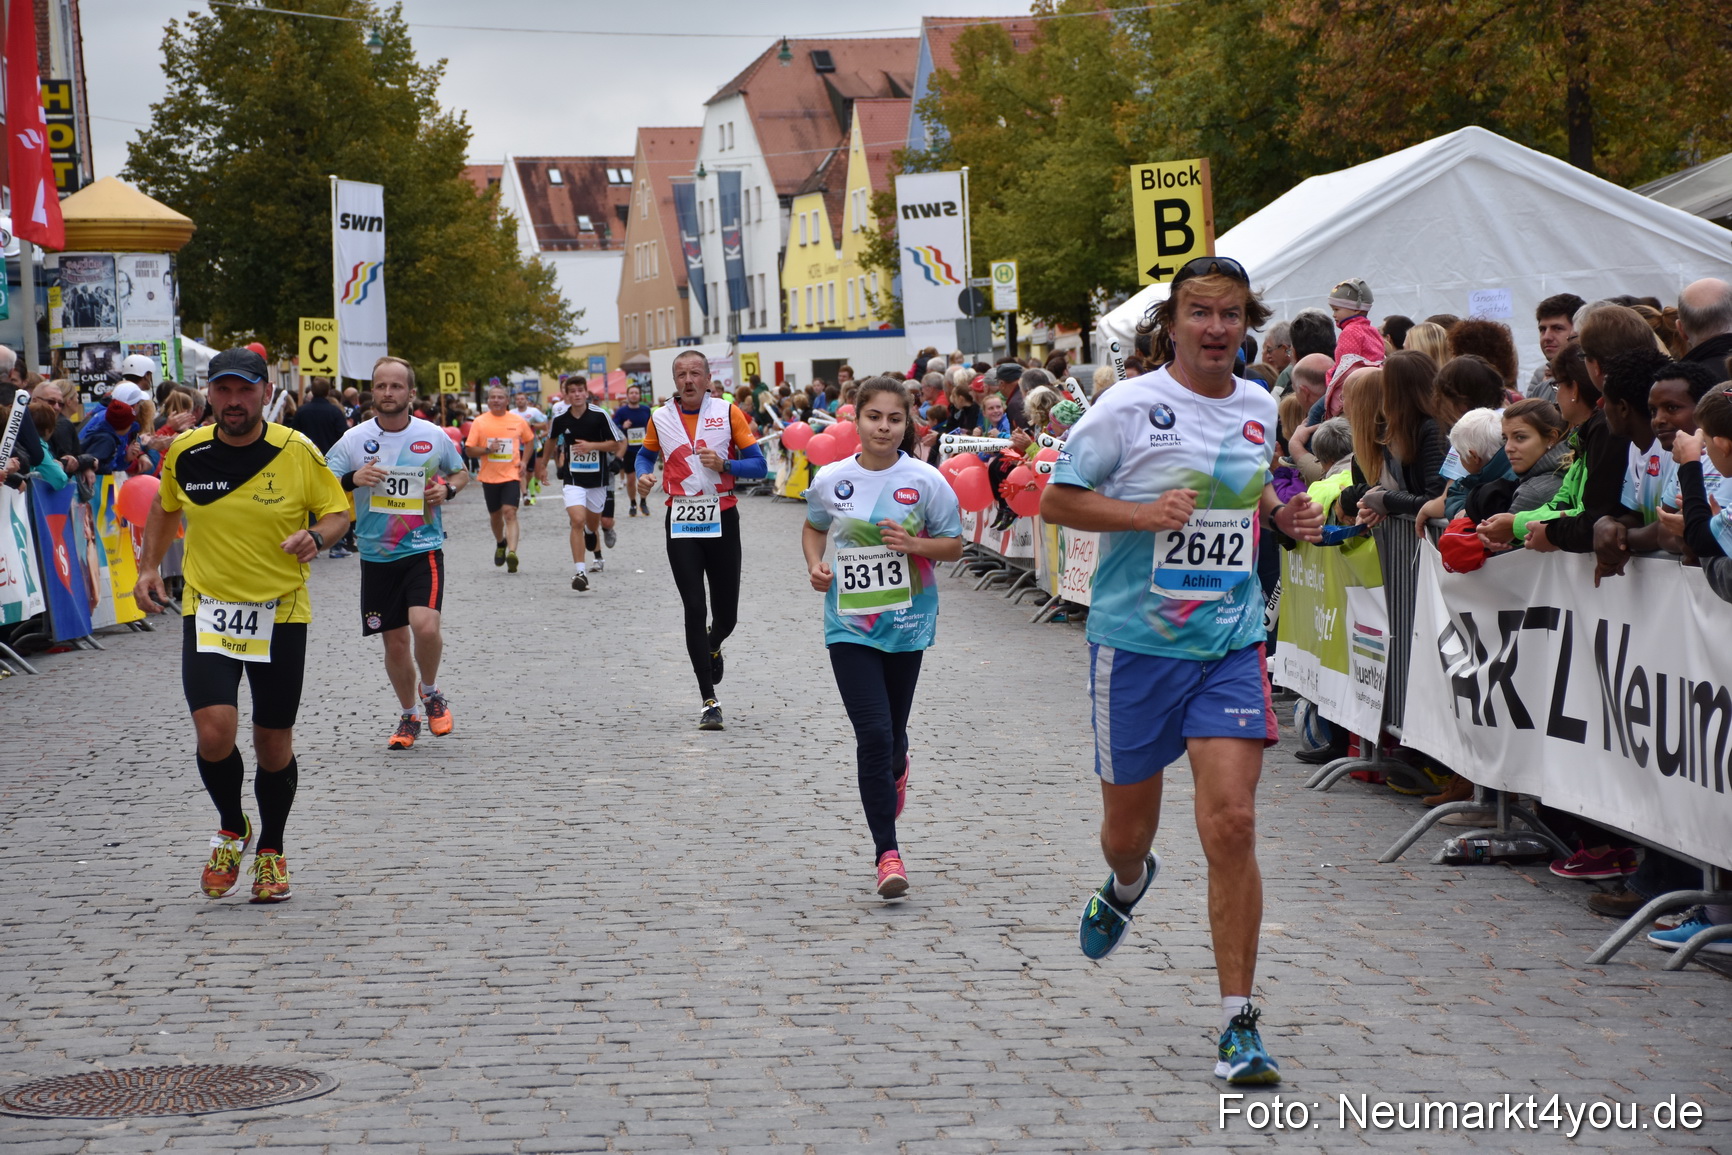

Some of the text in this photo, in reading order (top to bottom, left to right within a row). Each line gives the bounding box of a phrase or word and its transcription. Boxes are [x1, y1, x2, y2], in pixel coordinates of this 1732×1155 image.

[1140, 165, 1202, 190] Block
[340, 212, 383, 232] swn
[1153, 198, 1195, 257] B
[303, 320, 334, 332] Block
[308, 335, 329, 363] C
[745, 361, 756, 376] D
[445, 372, 456, 386] D
[8, 410, 23, 436] BMW
[1150, 433, 1182, 442] PARTL
[958, 445, 978, 453] BMW
[573, 452, 597, 462] 2578
[185, 481, 230, 491] Bernd W.
[386, 477, 409, 496] 30
[252, 493, 286, 506] Burgthann
[387, 499, 406, 508] Maze
[676, 505, 716, 522] 2237
[1195, 519, 1238, 528] Neumarkt
[1165, 530, 1245, 566] 2642
[837, 551, 894, 562] PARTL Neumarkt
[844, 560, 903, 590] 5313
[1182, 574, 1222, 588] Achim
[212, 608, 258, 635] 344
[221, 638, 248, 652] Bernd
[1595, 618, 1732, 794] Neum
